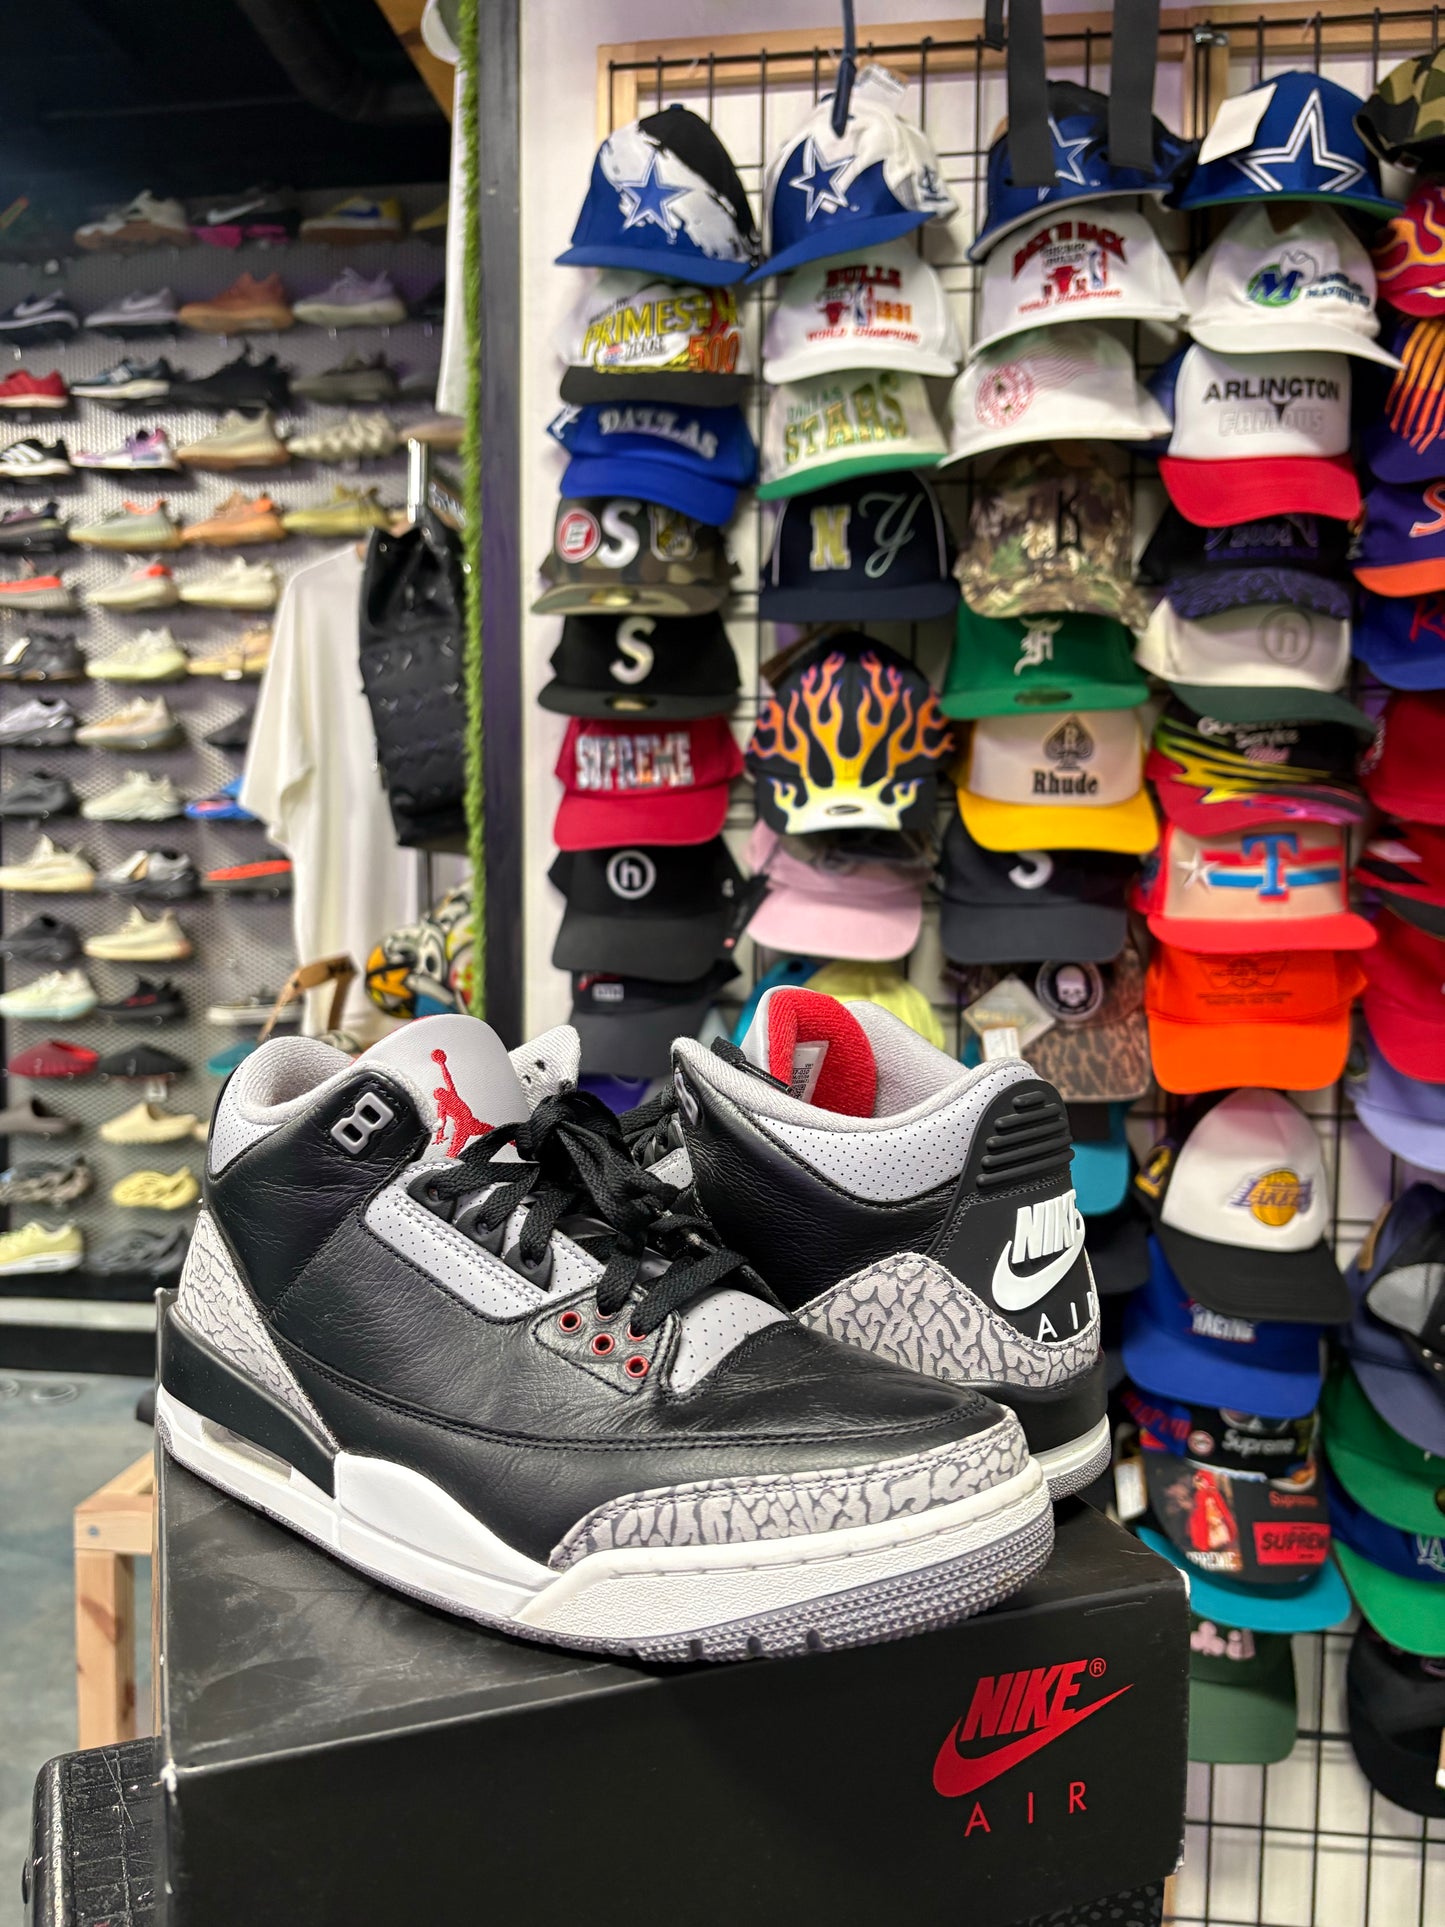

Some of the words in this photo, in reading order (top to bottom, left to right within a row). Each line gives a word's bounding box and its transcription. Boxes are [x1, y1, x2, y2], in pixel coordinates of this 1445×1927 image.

[688, 329, 740, 374] 500
[785, 373, 907, 463] STARS
[1202, 378, 1340, 404] ARLINGTON
[598, 406, 719, 460] DALLAS
[596, 500, 641, 569] S
[609, 616, 657, 684] S
[576, 732, 695, 790] SUPREME
[1032, 768, 1098, 796] Rhude
[1241, 833, 1299, 902] T
[1222, 1428, 1296, 1458] Supreme
[964, 1781, 1088, 1837] AIR
